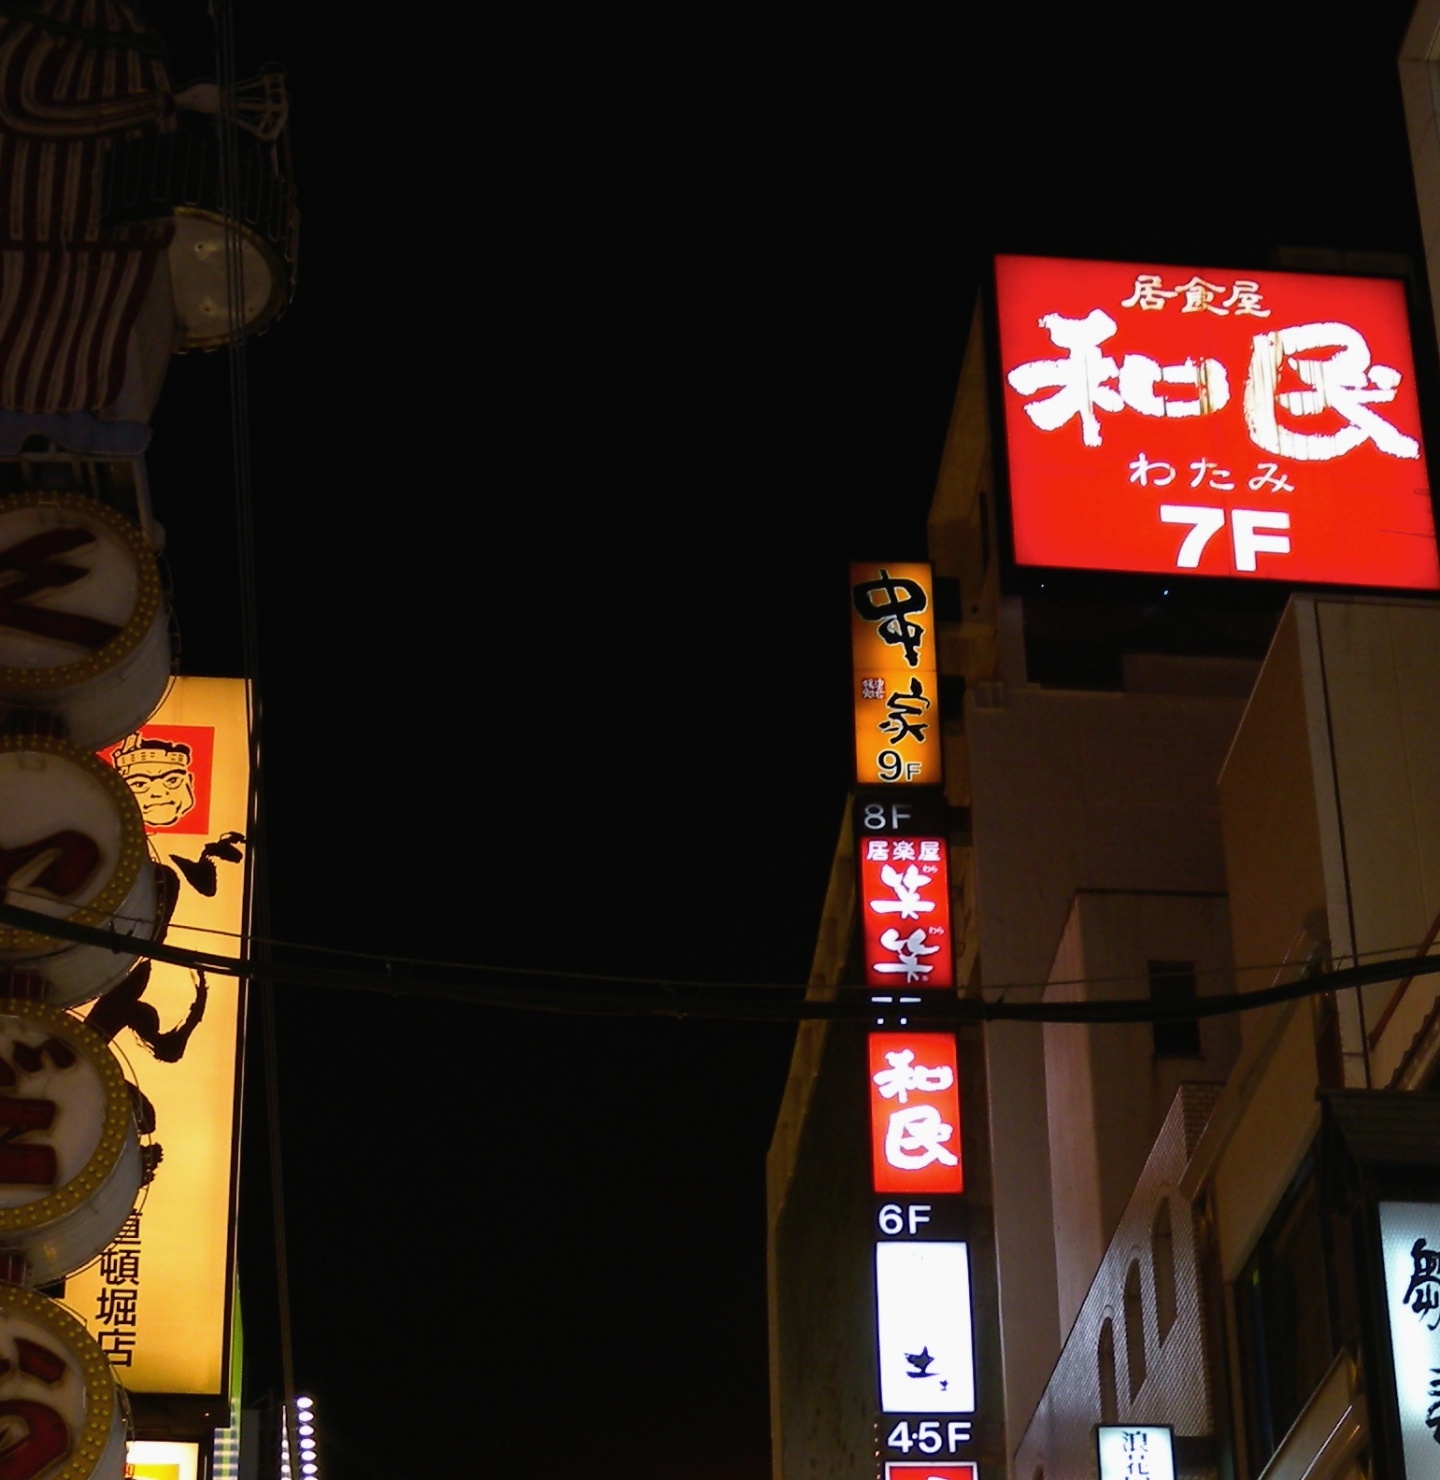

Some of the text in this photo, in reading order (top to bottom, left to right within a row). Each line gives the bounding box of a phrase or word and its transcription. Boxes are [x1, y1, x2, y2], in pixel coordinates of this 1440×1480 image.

[1120, 275, 1271, 318] 居食屋
[1007, 308, 1420, 461] 和民
[1129, 452, 1295, 493] わたみ
[1160, 504, 1291, 572] 7F
[852, 568, 931, 743] 串家
[877, 749, 921, 782] 9F
[863, 804, 912, 830] 8F
[866, 840, 941, 862] 居楽屋
[874, 1049, 958, 1170] 和民
[878, 1203, 932, 1236] 6F
